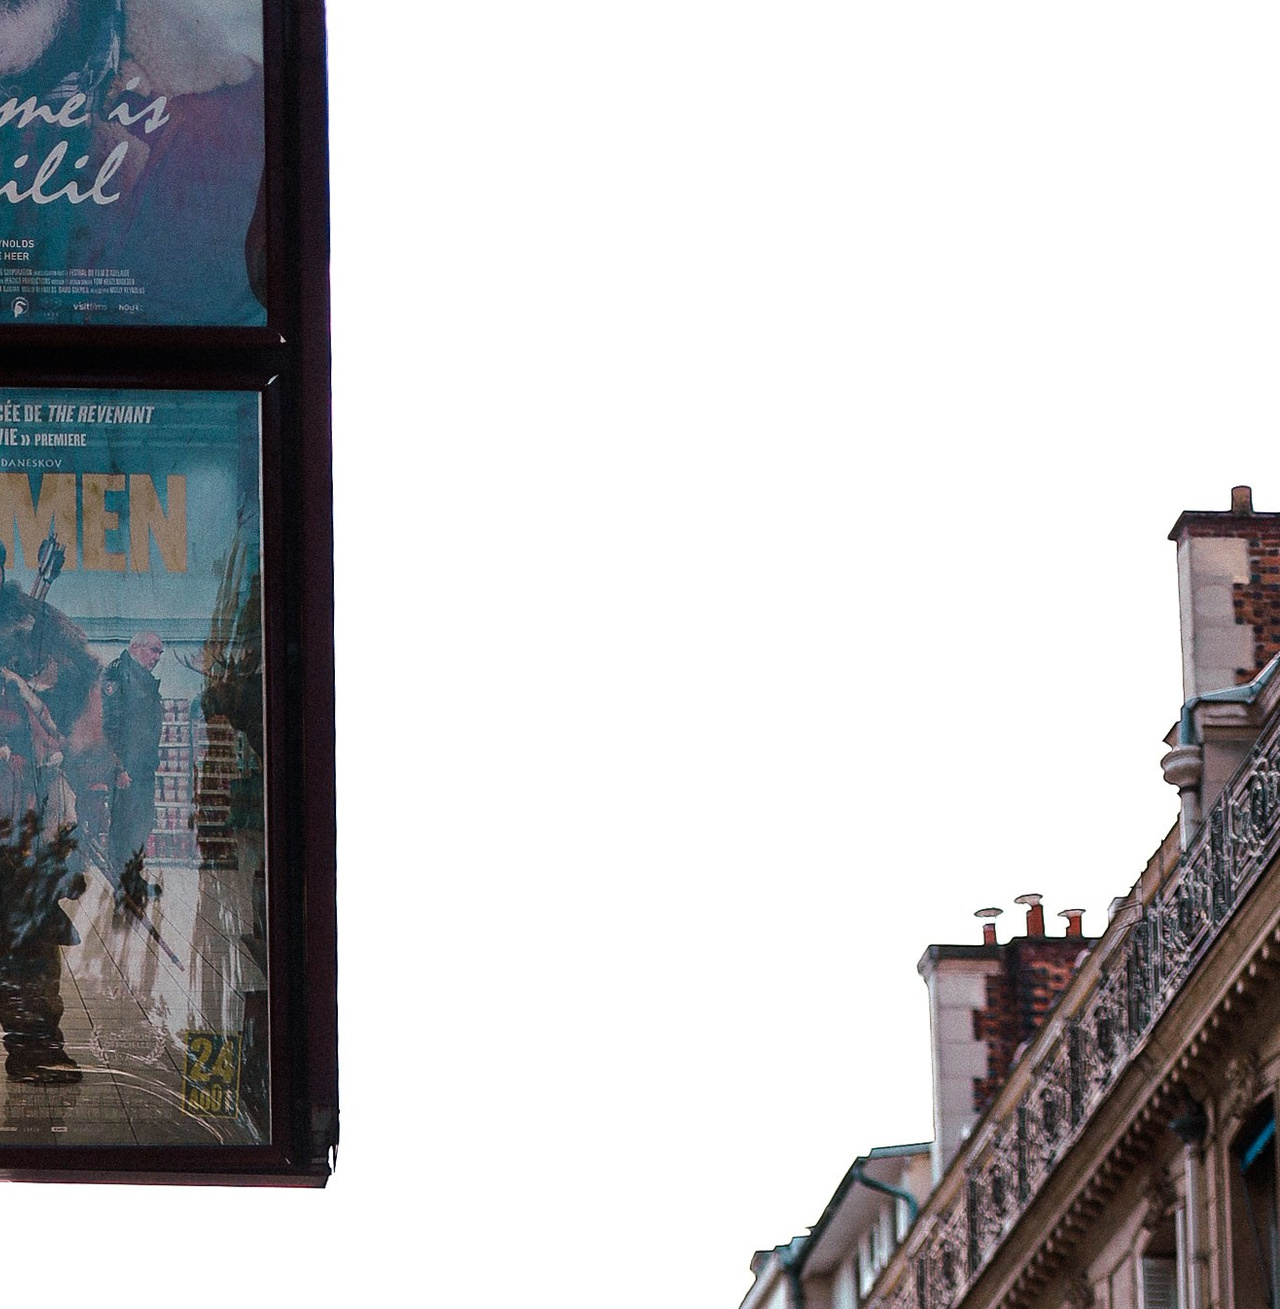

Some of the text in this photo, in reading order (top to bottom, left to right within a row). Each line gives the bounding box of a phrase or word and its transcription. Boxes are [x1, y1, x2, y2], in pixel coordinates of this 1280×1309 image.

[107, 77, 170, 134] is
[4, 252, 30, 261] HEER
[24, 404, 43, 423] DE
[48, 404, 76, 423] THE
[77, 405, 155, 424] REVENANT
[34, 433, 87, 447] PREMIERE
[0, 458, 63, 469] DANESKOV
